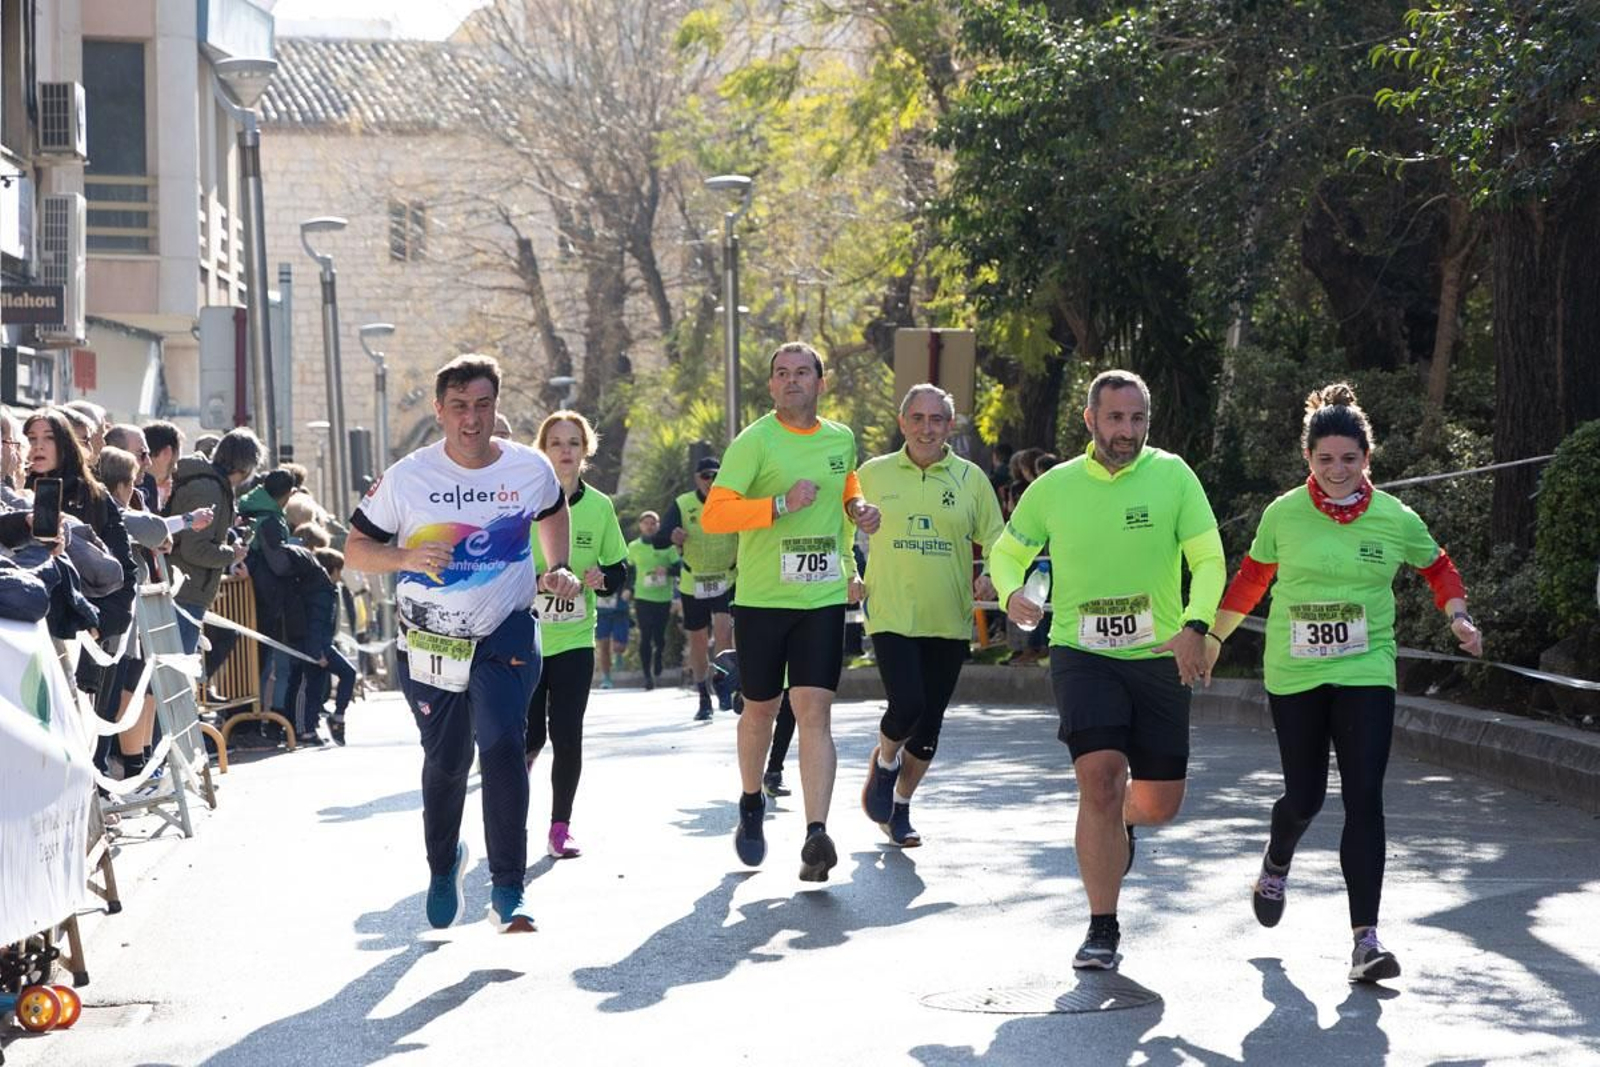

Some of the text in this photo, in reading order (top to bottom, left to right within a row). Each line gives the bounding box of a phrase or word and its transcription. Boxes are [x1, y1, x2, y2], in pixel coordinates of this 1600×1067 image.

[796, 553, 828, 573] 705
[544, 596, 575, 613] 706
[1096, 614, 1137, 637] 450
[1307, 622, 1348, 645] 380
[430, 654, 443, 676] 11
